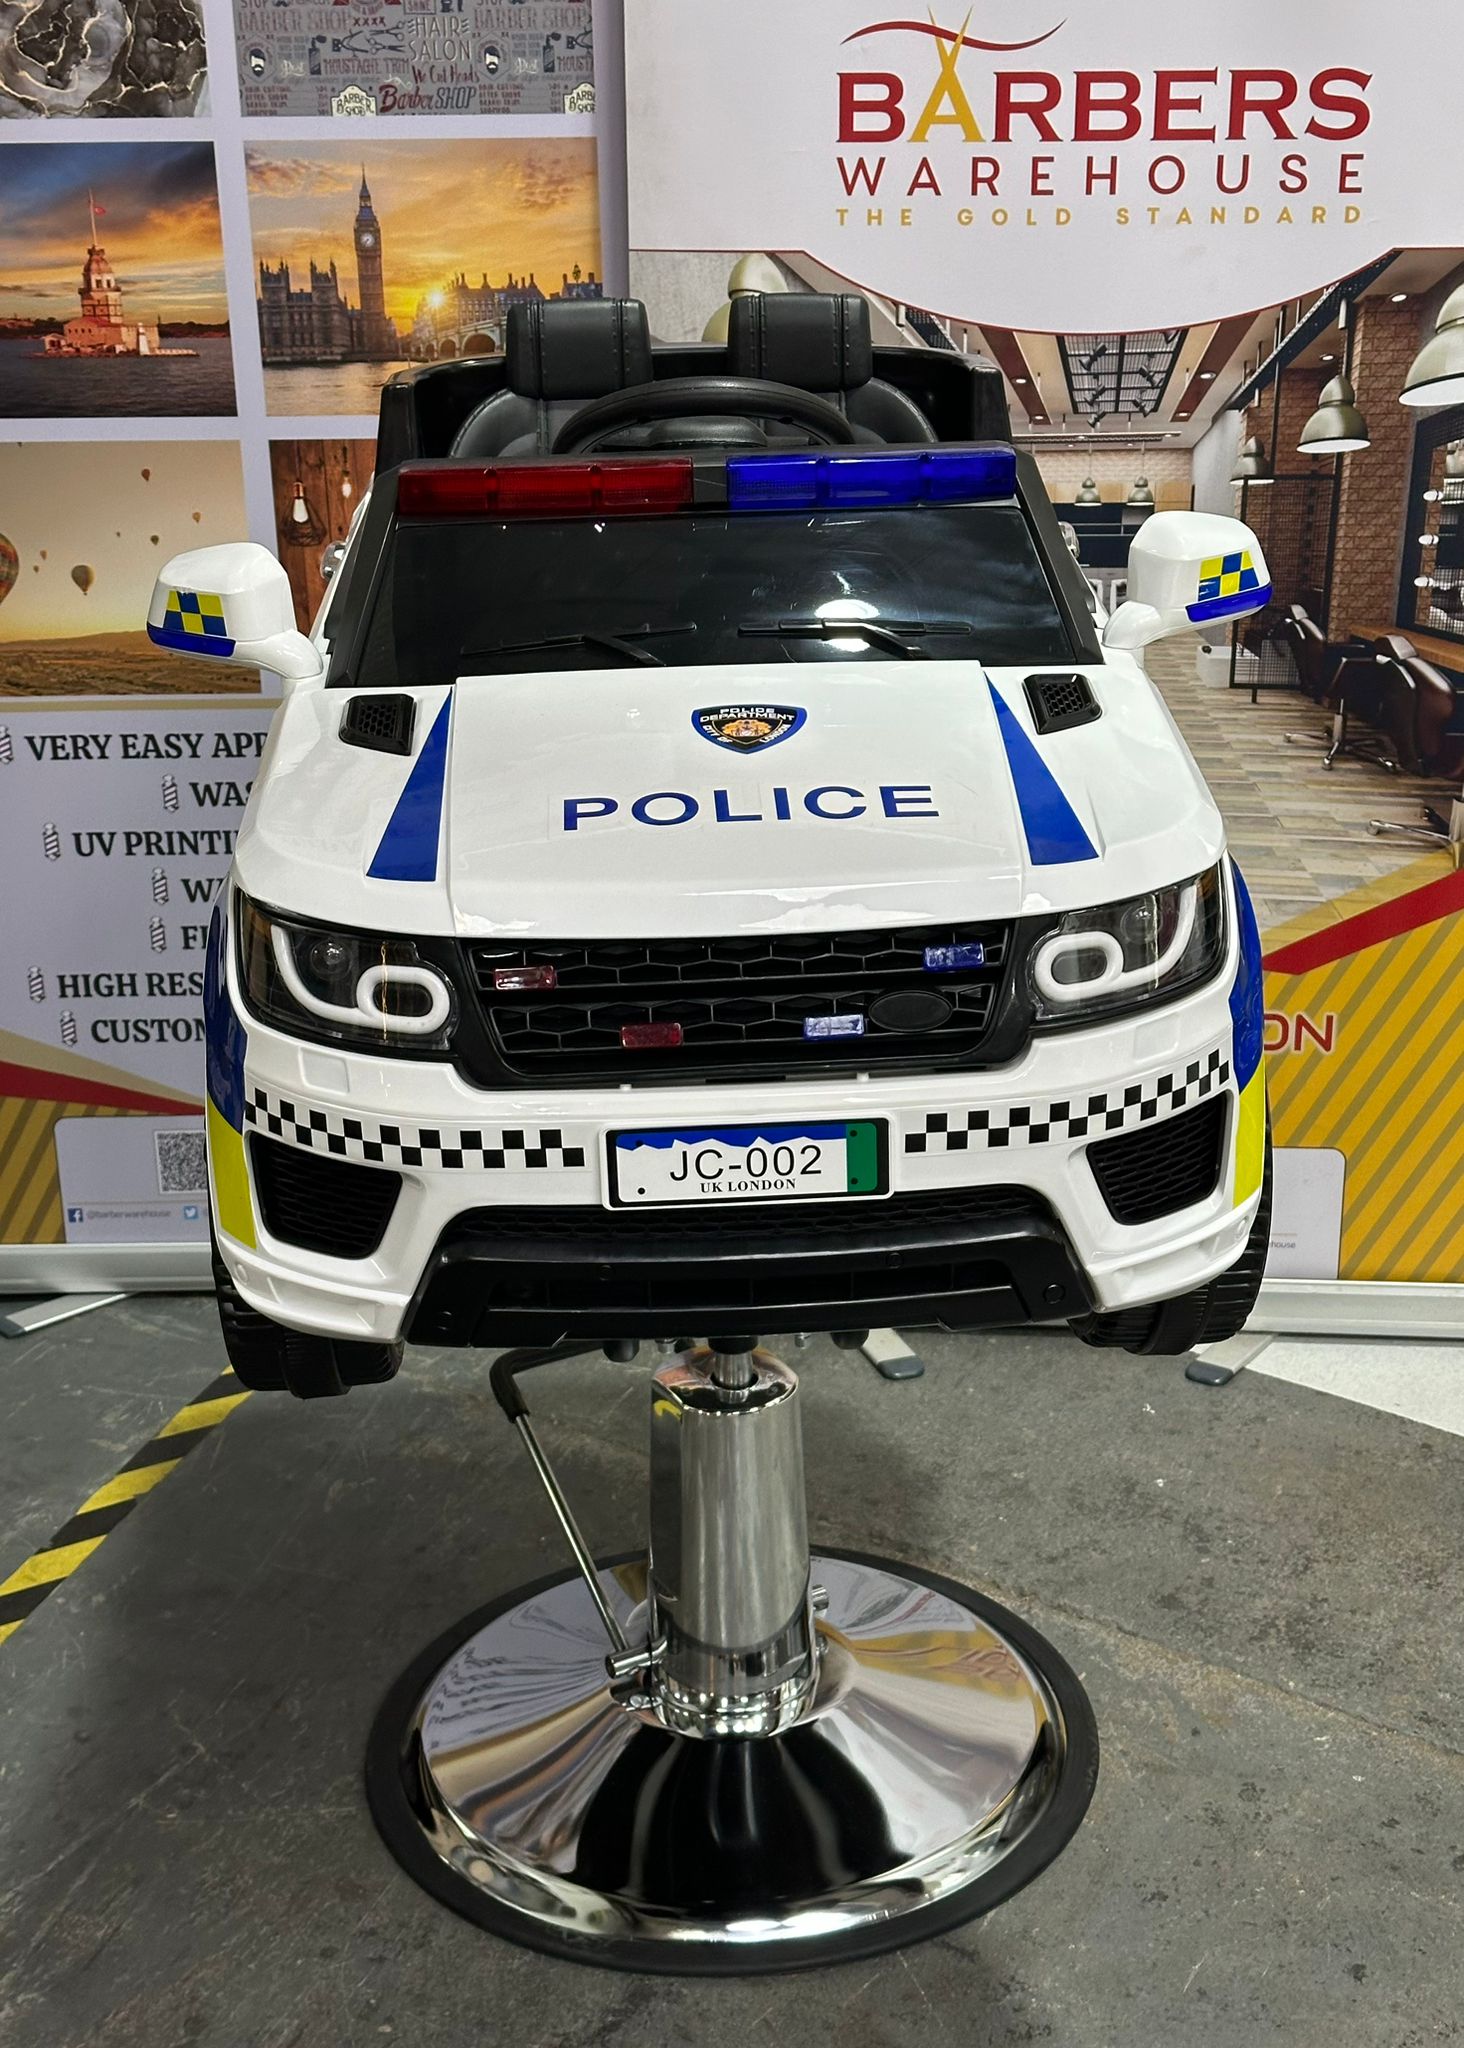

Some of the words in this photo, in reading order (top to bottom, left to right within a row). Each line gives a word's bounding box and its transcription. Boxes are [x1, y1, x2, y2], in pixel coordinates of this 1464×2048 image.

[415, 16, 461, 38] HAIR
[408, 40, 473, 62] SALON
[378, 84, 435, 113] Barber
[435, 86, 477, 109] SHOP
[836, 60, 1374, 143] BARBERS
[836, 153, 1365, 196] WAREHOUSE
[836, 208, 913, 226] THE
[957, 208, 1072, 226] GOLD
[1116, 205, 1362, 226] STANDARD
[700, 713, 795, 723] DEPARTMENT
[24, 734, 110, 761] VERY
[119, 733, 203, 760] EASY
[563, 785, 939, 831] POLICE
[72, 832, 116, 857] UV
[124, 830, 239, 856] PRINTI
[57, 973, 139, 998] HIGH
[145, 972, 203, 997] RES
[669, 1145, 822, 1181] JC-002
[700, 1182, 723, 1193] UK
[728, 1178, 797, 1192] LONDON
